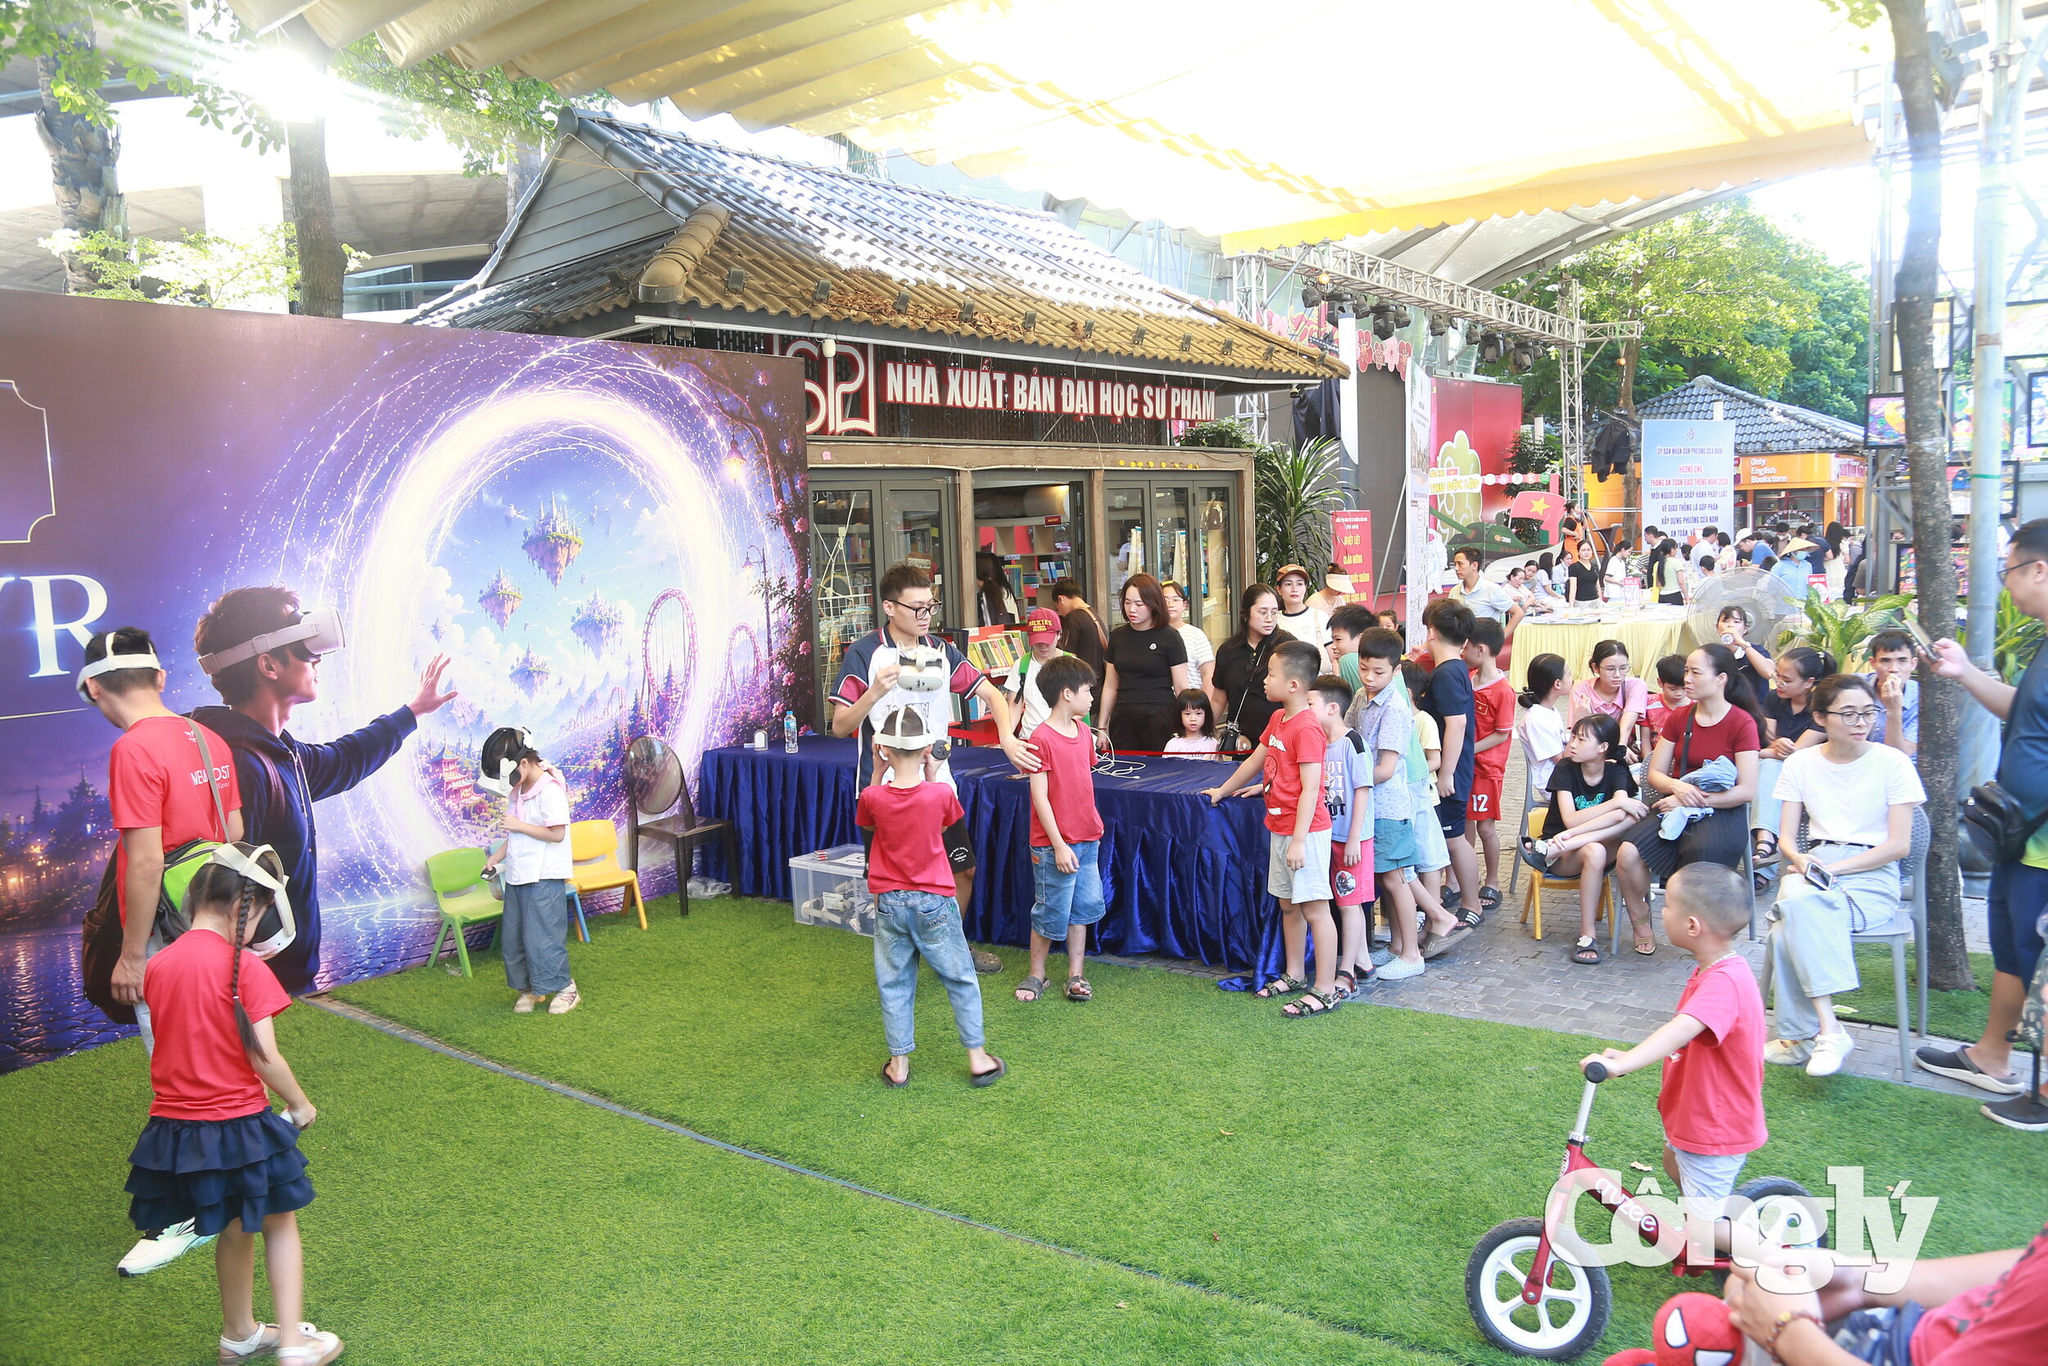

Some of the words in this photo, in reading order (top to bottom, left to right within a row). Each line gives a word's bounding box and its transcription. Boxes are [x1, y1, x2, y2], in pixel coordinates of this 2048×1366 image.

[886, 358, 940, 405] NHÀ
[946, 358, 1007, 409] XUẤT
[1013, 367, 1056, 412] BẢN
[1061, 378, 1095, 422] ĐẠI
[1099, 381, 1139, 423] HỌC
[1142, 383, 1168, 420] SƯ
[1750, 458, 1766, 467] Only
[1751, 467, 1776, 476] English
[1751, 475, 1788, 483] Bookstore
[0, 574, 108, 678] R
[1472, 794, 1489, 813] 12
